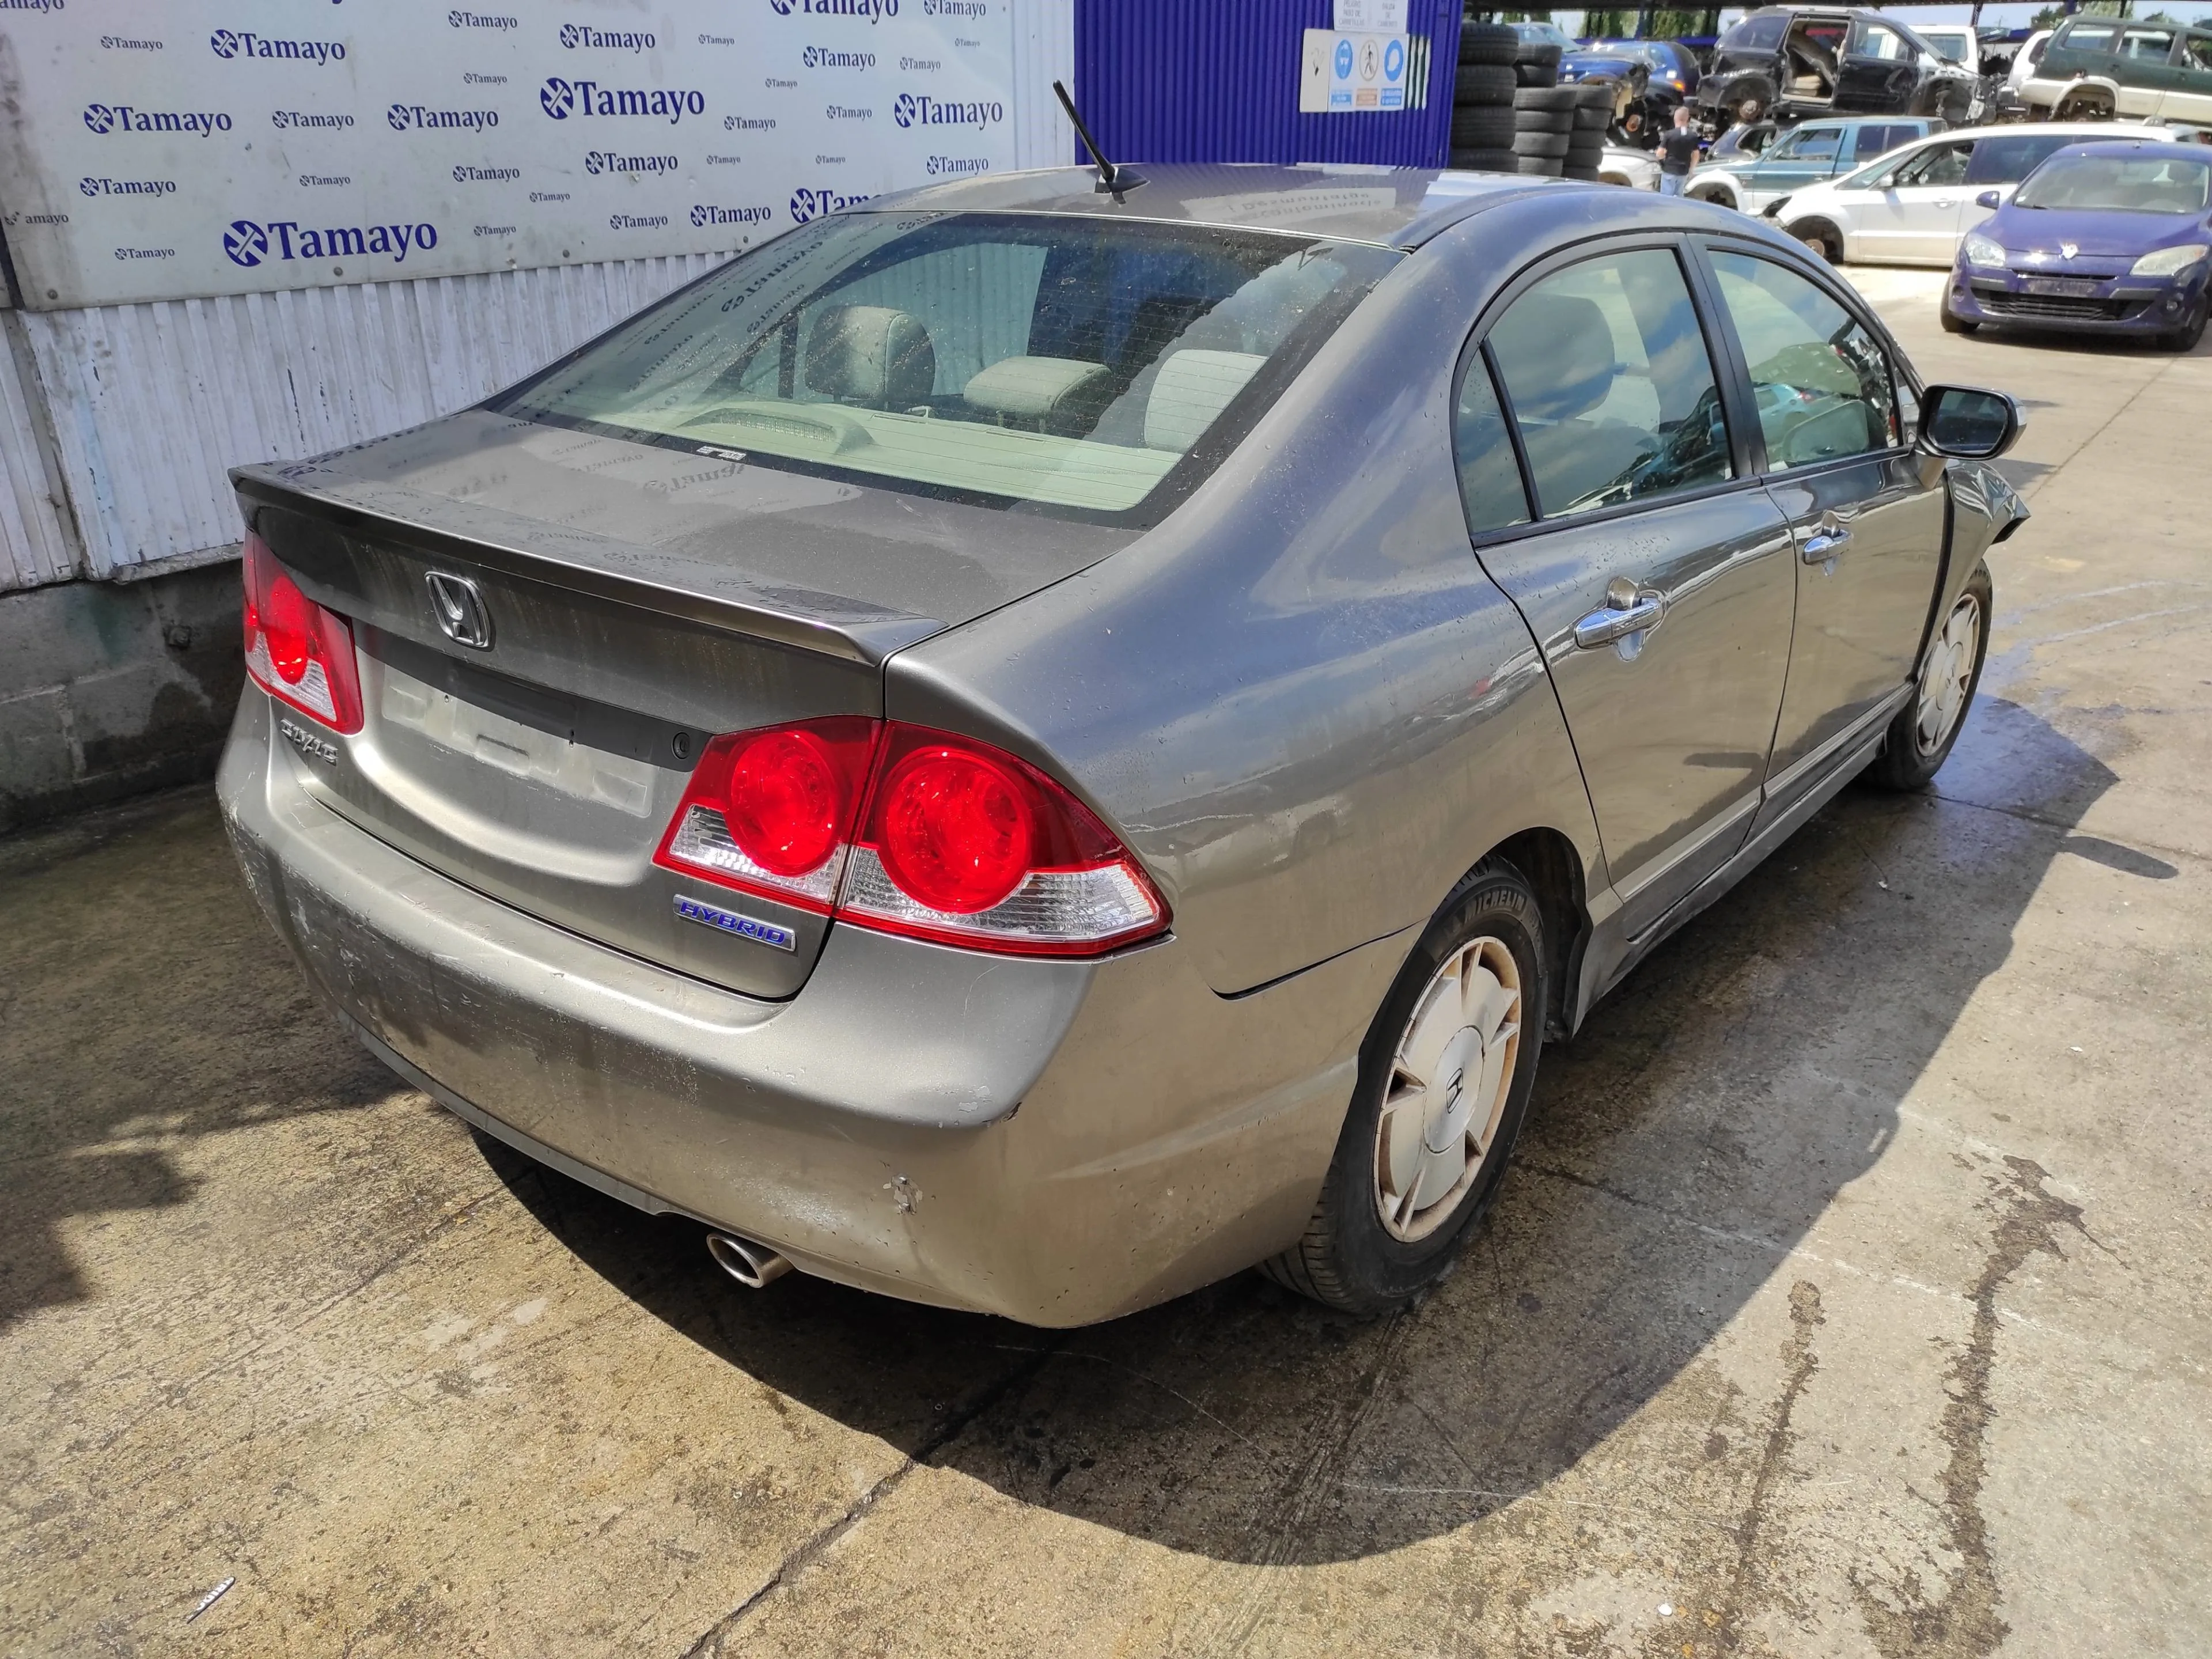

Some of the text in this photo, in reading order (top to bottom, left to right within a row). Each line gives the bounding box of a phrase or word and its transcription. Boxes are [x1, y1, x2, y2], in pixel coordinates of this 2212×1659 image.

[0, 0, 64, 14] amayo
[935, 0, 986, 20] Tamayo
[463, 13, 517, 32] Tamayo
[112, 37, 162, 51] Tamayo
[238, 33, 345, 66] Tamayo
[579, 27, 655, 54] Tamayo
[706, 35, 734, 46] Tamayo
[819, 48, 875, 71] Tamayo
[907, 58, 940, 72] Tamayo
[472, 74, 507, 85] Tamayo
[772, 79, 797, 89] Tamayo
[574, 82, 704, 124] Tamayo
[113, 107, 232, 138] Tamayo
[289, 112, 354, 130] Tamayo
[410, 107, 498, 132] Tamayo
[835, 107, 872, 120] Tamayo
[917, 97, 1002, 130] Tamayo
[734, 117, 775, 131] Tamayo
[604, 153, 677, 175] Tamayo
[712, 156, 740, 165] Tamayo
[824, 156, 846, 165] Tamayo
[940, 157, 988, 175] Tamayo
[309, 176, 350, 187] Tamayo
[465, 167, 520, 182] Tamayo
[99, 179, 176, 197] Tamayo
[536, 193, 570, 202] Tamayo
[816, 190, 882, 215] Tam
[25, 215, 69, 226] amayo
[620, 215, 668, 229] Tamayo
[706, 206, 771, 226] Tamayo
[482, 226, 516, 235] Tamayo
[267, 222, 437, 263] Tamayo
[126, 249, 175, 259] Tamayo
[1464, 890, 1525, 924] MICHELIN
[679, 902, 785, 945] HYBRID
